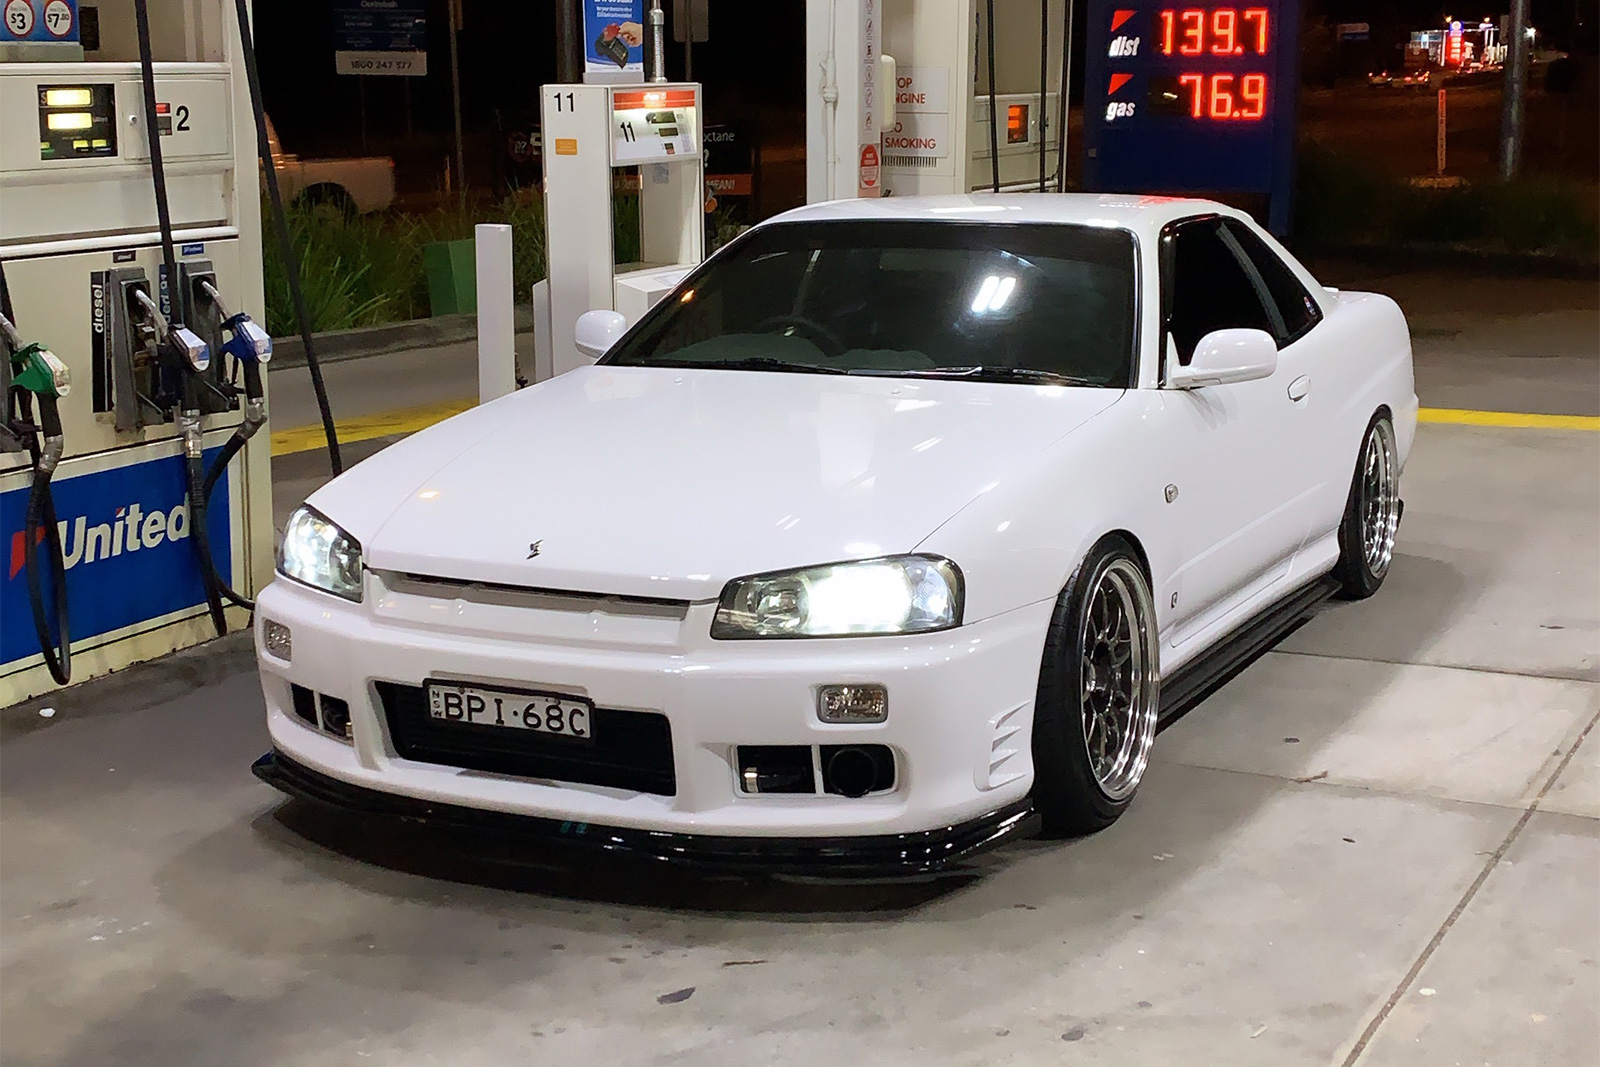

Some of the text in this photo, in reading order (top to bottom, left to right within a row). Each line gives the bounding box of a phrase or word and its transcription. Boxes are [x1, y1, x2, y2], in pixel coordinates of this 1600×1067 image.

[1160, 7, 1270, 56] 139.7
[1108, 35, 1141, 57] dist
[553, 92, 575, 112] 11
[1180, 72, 1266, 120] 76.9
[175, 105, 190, 131] 2
[1105, 99, 1136, 121] gas
[620, 121, 636, 142] 11
[884, 137, 937, 149] SMOKING
[92, 284, 104, 334] diesel
[57, 491, 190, 570] United
